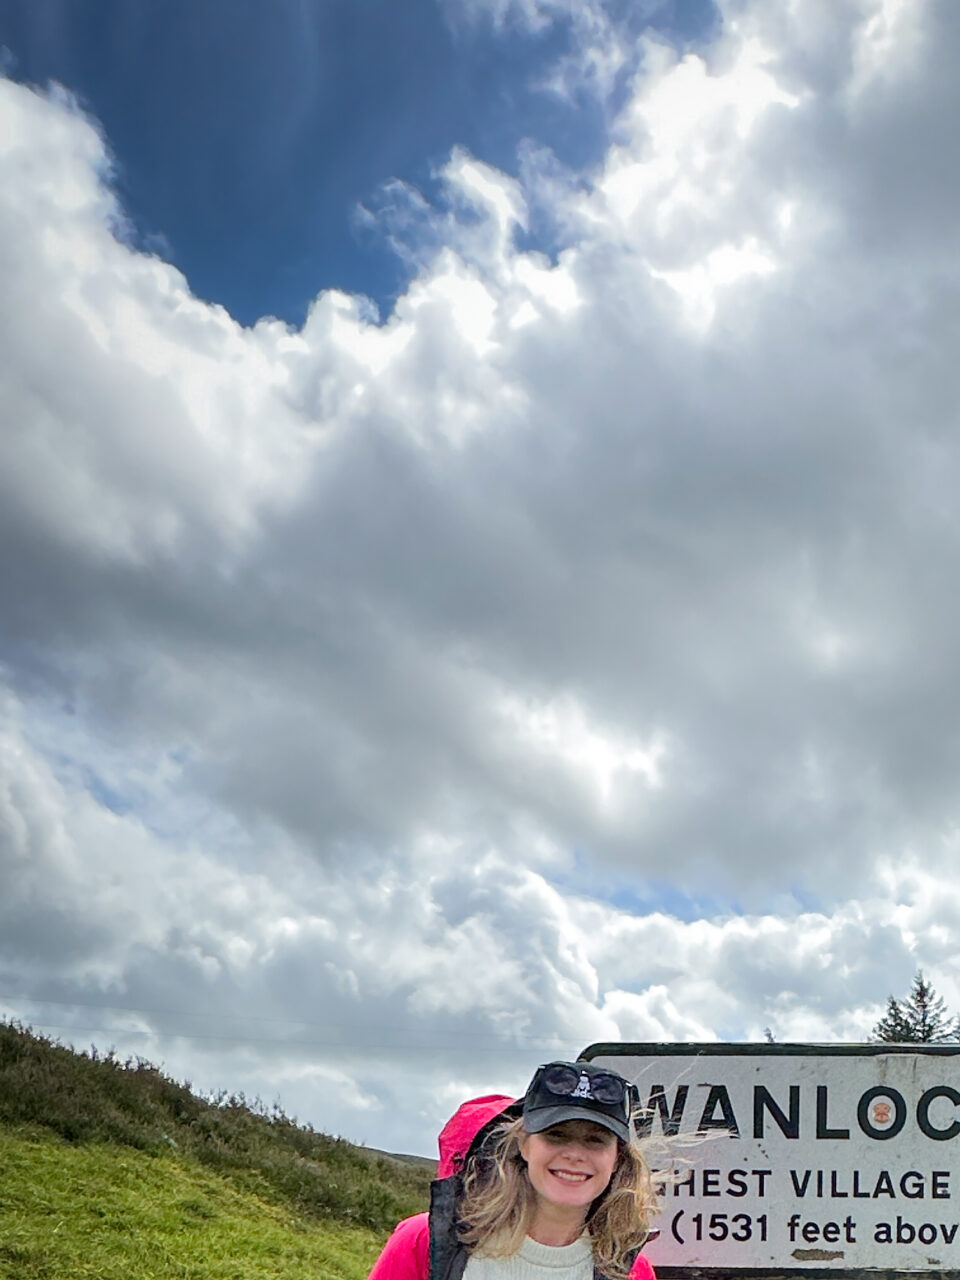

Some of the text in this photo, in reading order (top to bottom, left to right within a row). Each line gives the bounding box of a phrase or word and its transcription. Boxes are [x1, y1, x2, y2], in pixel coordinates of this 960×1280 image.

[790, 1169, 951, 1199] VILLAGE
[671, 1209, 768, 1245] (1531
[787, 1214, 856, 1243] feet
